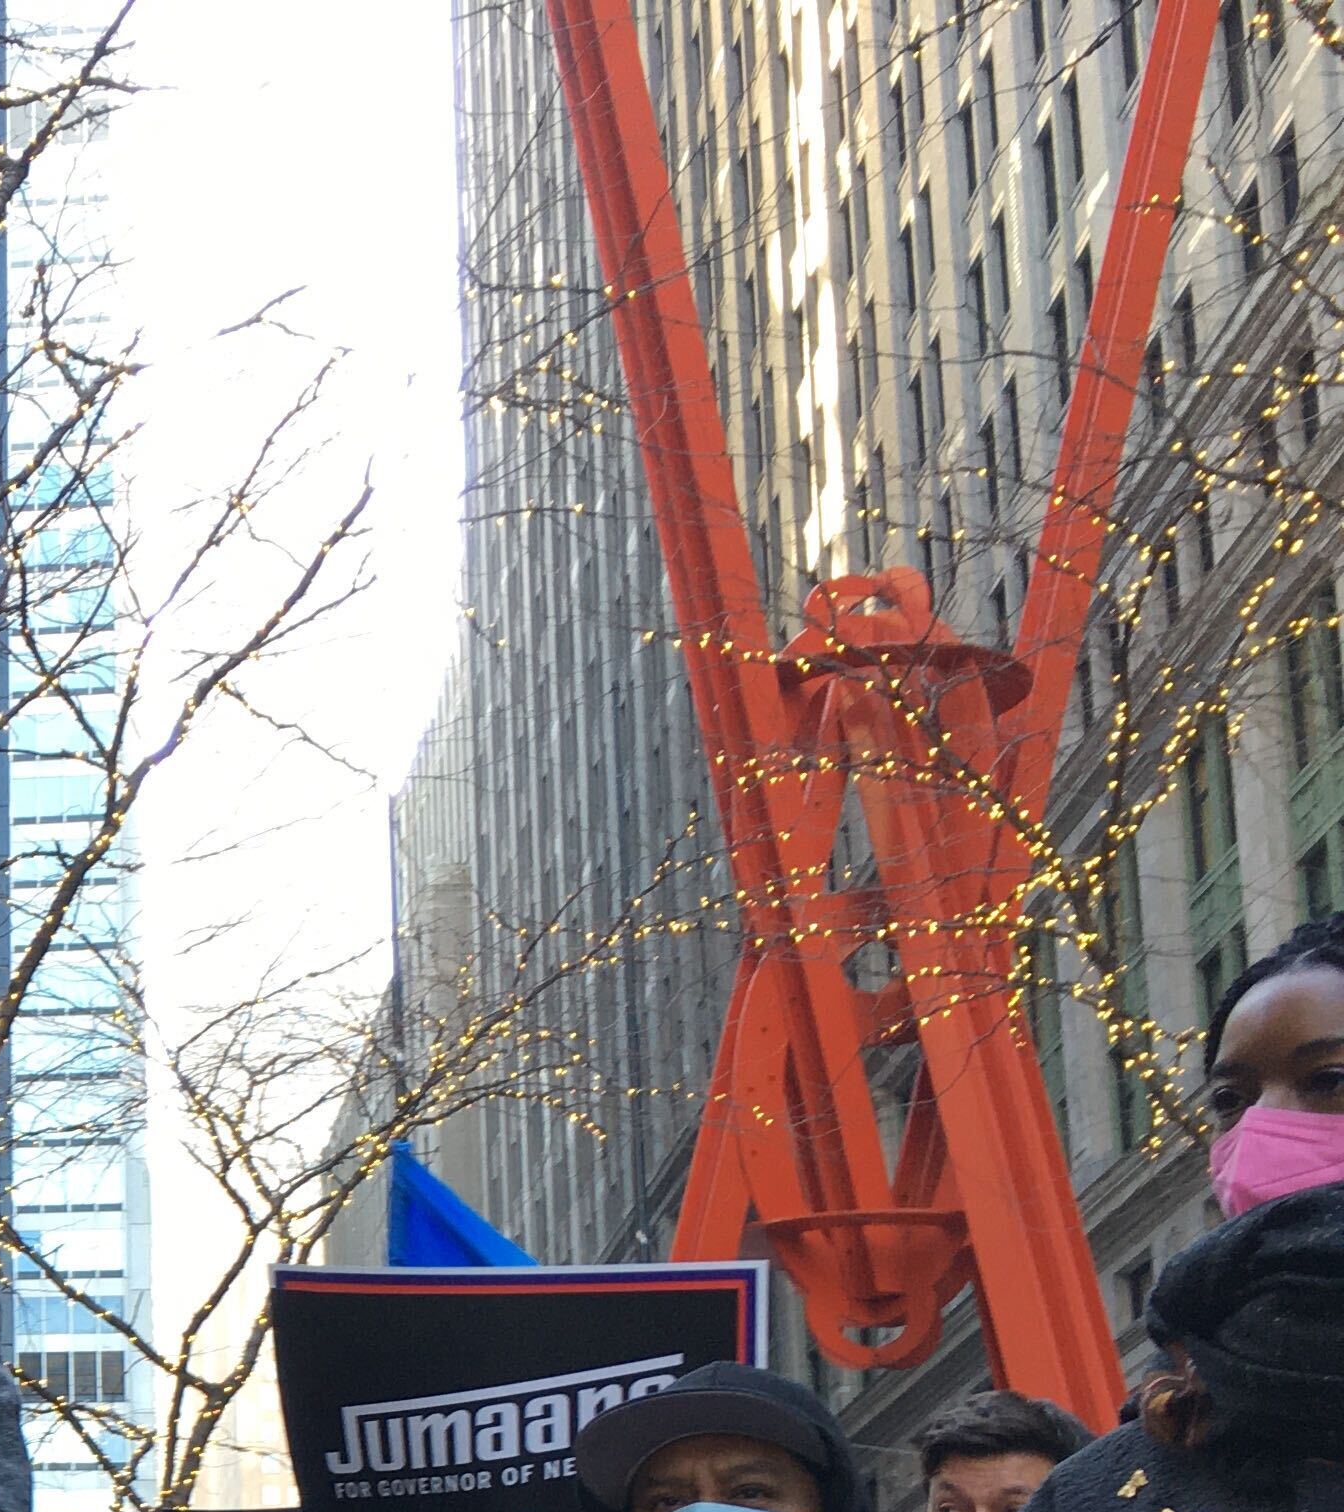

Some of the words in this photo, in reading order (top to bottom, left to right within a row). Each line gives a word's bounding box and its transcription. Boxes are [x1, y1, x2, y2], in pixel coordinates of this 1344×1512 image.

[334, 1481, 371, 1499] FOR
[377, 1470, 492, 1497] GOVERNOR
[501, 1464, 535, 1487] OF
